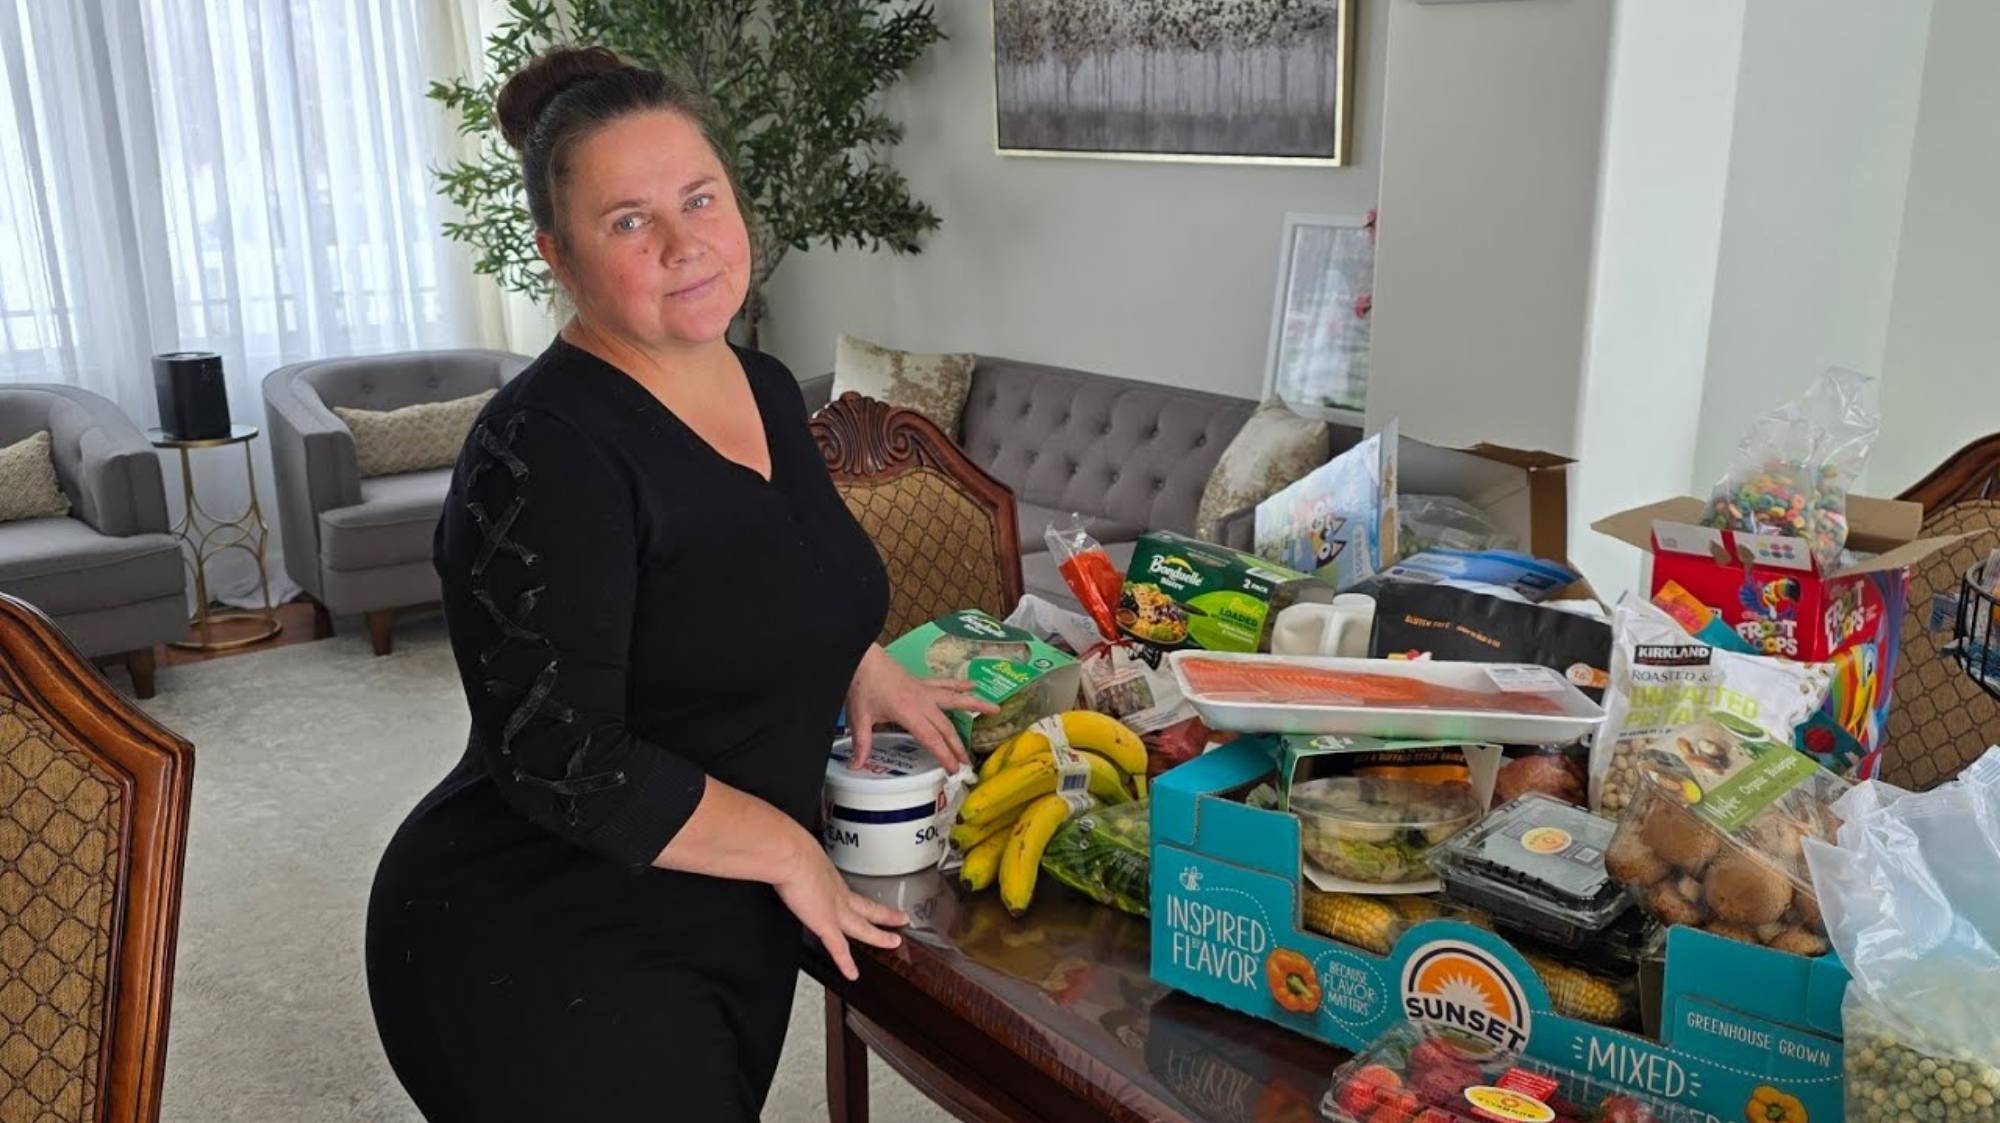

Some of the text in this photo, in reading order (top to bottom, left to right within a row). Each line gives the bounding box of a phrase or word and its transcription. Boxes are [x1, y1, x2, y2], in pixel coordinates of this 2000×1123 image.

[1149, 554, 1204, 587] Bonduelle
[1242, 578, 1252, 591] 2
[1735, 619, 1798, 639] FROOT
[1638, 645, 1710, 659] KIRKLAND
[1751, 636, 1799, 656] OOPS
[1631, 668, 1696, 683] ROASTED
[827, 823, 859, 848] EAM
[914, 825, 940, 846] SO
[1166, 893, 1267, 955] INSPIRED
[1172, 931, 1258, 991] FLAVOR
[1329, 960, 1368, 987] BECAUSE
[1323, 972, 1377, 1004] FLAVOR
[1327, 990, 1369, 1017] MATTERS
[1405, 997, 1527, 1052] SUNSET
[1686, 1011, 1832, 1069] GREENHOUSE GROWN
[1587, 1036, 1686, 1098] MIXED
